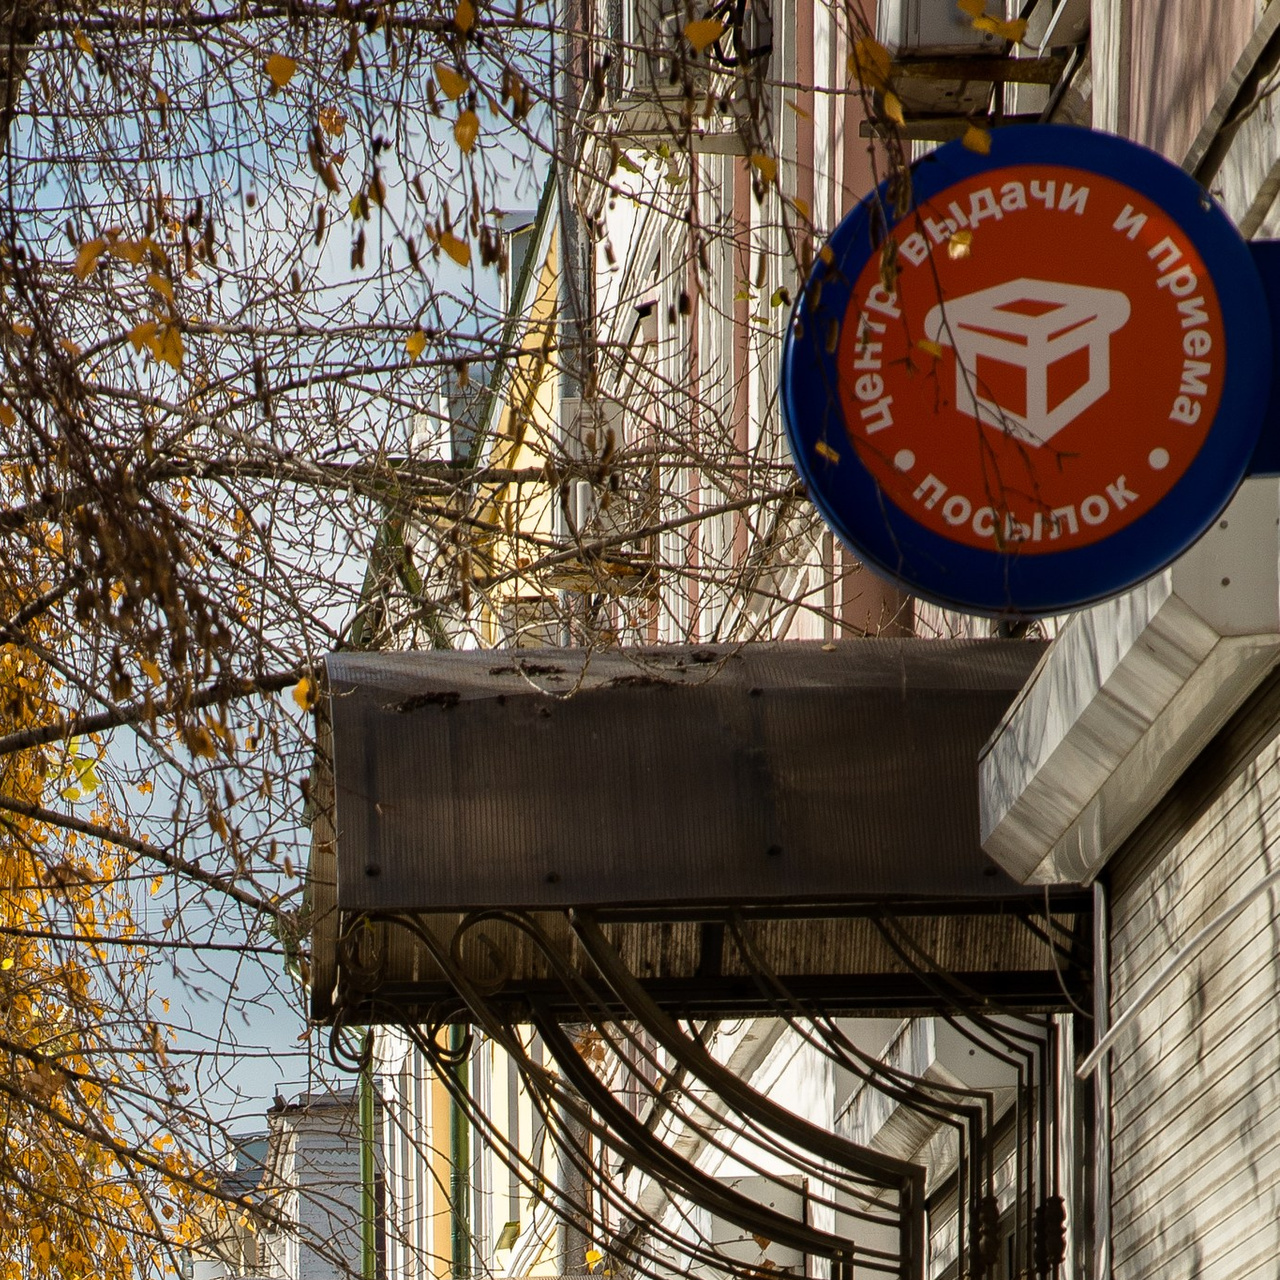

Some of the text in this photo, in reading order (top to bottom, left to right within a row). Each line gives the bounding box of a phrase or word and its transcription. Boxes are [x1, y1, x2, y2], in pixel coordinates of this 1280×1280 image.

[854, 179, 1213, 434] центр выдачи и приема
[913, 472, 1142, 542] посылок
